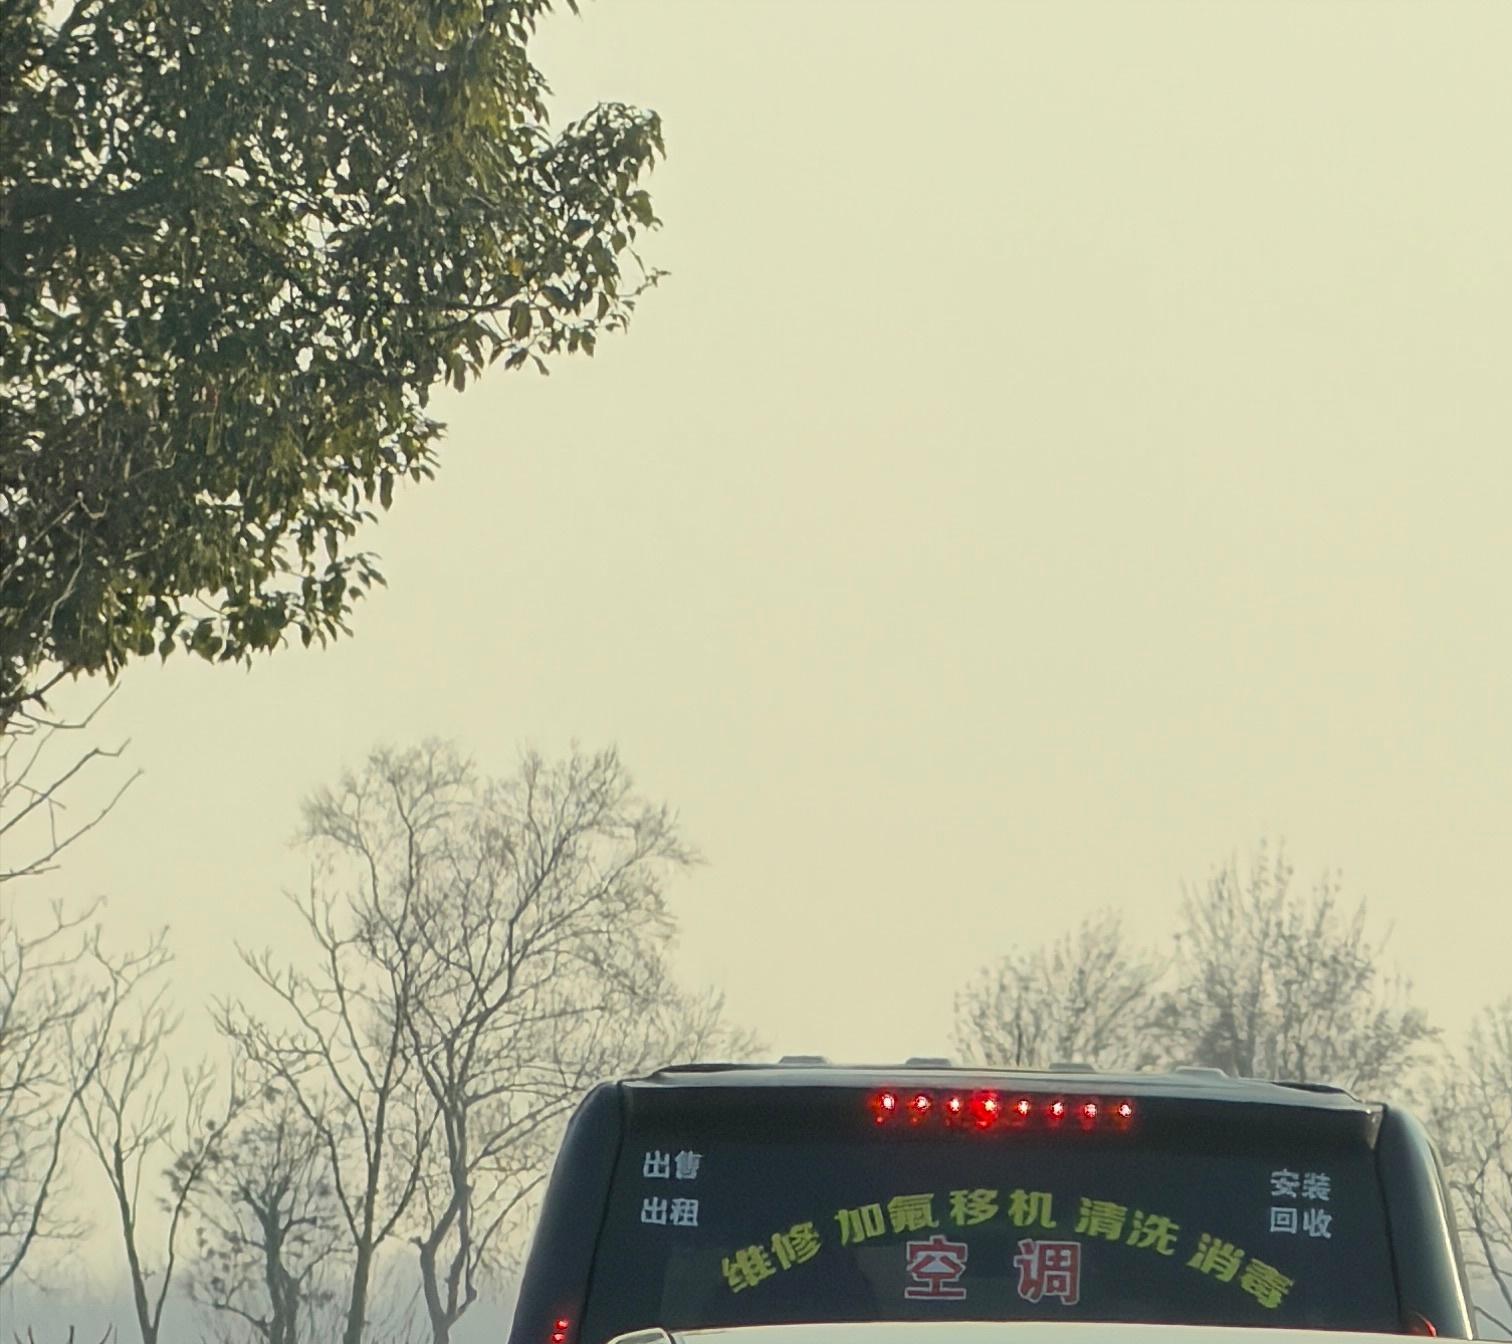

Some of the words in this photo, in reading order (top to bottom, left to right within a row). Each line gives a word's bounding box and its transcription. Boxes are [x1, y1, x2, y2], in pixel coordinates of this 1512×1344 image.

[643, 1150, 703, 1180] 出售
[1269, 1168, 1332, 1201] 安装
[641, 1196, 699, 1226] 出租
[1269, 1206, 1333, 1239] 回收
[720, 1220, 823, 1294] 维修
[834, 1192, 941, 1245] 加氟
[948, 1187, 1058, 1229] 移机
[1075, 1196, 1183, 1257] 清洗
[1185, 1231, 1296, 1309] 消毒
[904, 1234, 1082, 1306] 空调
